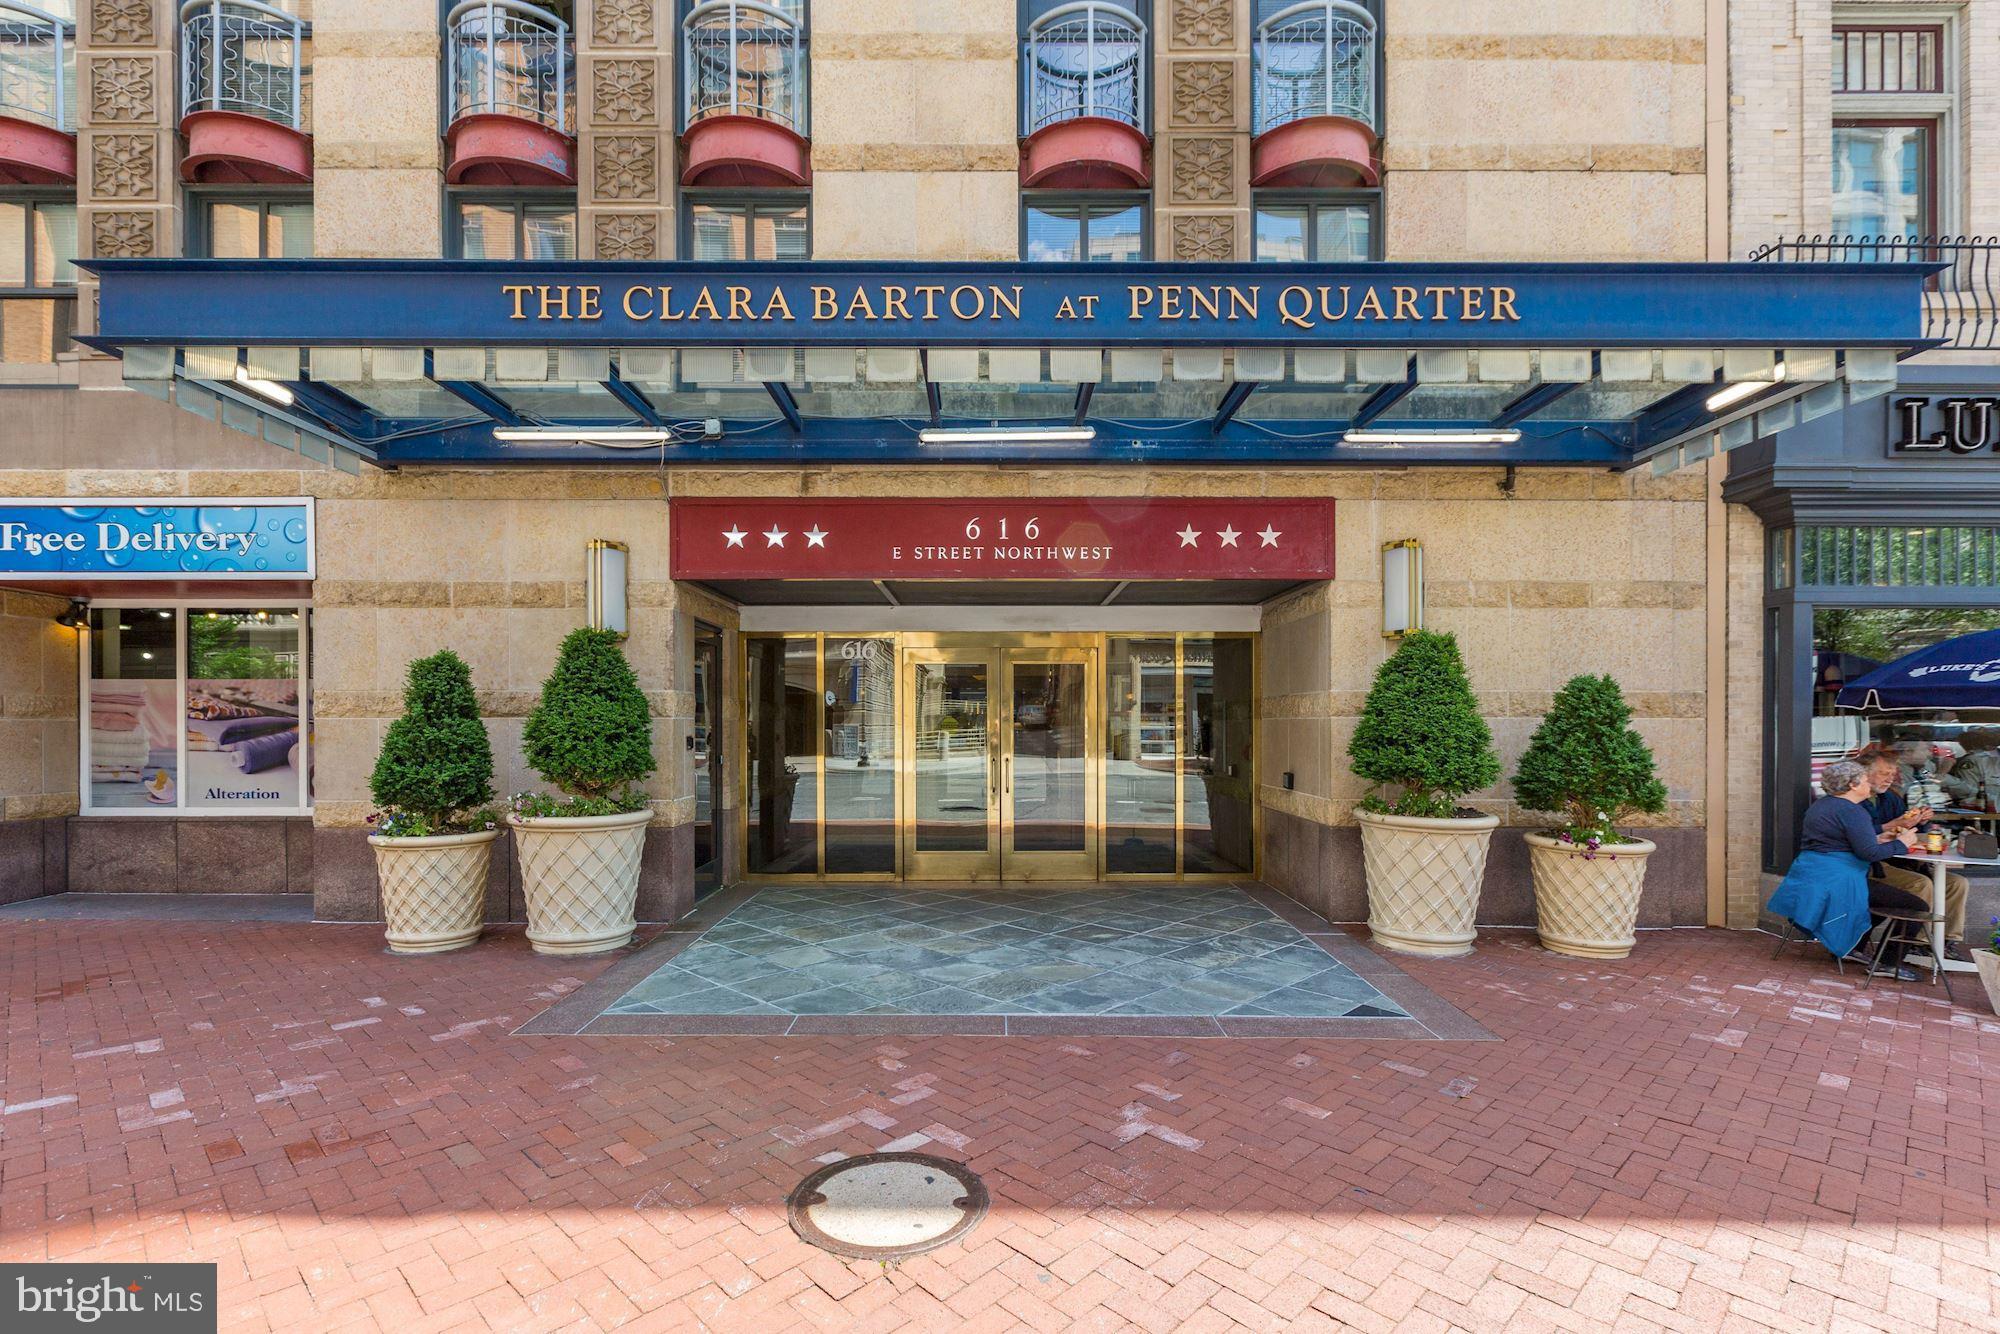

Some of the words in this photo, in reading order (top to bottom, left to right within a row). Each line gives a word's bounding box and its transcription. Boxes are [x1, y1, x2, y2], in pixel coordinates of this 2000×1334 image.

[503, 286, 602, 319] THE
[623, 286, 796, 320] CLARA
[811, 286, 1024, 320] BARTON
[1055, 296, 1099, 319] AT
[1127, 286, 1260, 320] PENN
[1278, 285, 1522, 328] QUARTER
[1895, 397, 2000, 454] LU
[0, 522, 86, 552] Free
[96, 522, 258, 556] Delivery
[892, 547, 902, 560] E
[914, 547, 985, 560] STREET
[994, 547, 1114, 560] NORTHWEST
[841, 640, 878, 660] 616
[205, 787, 281, 800] Alteration
